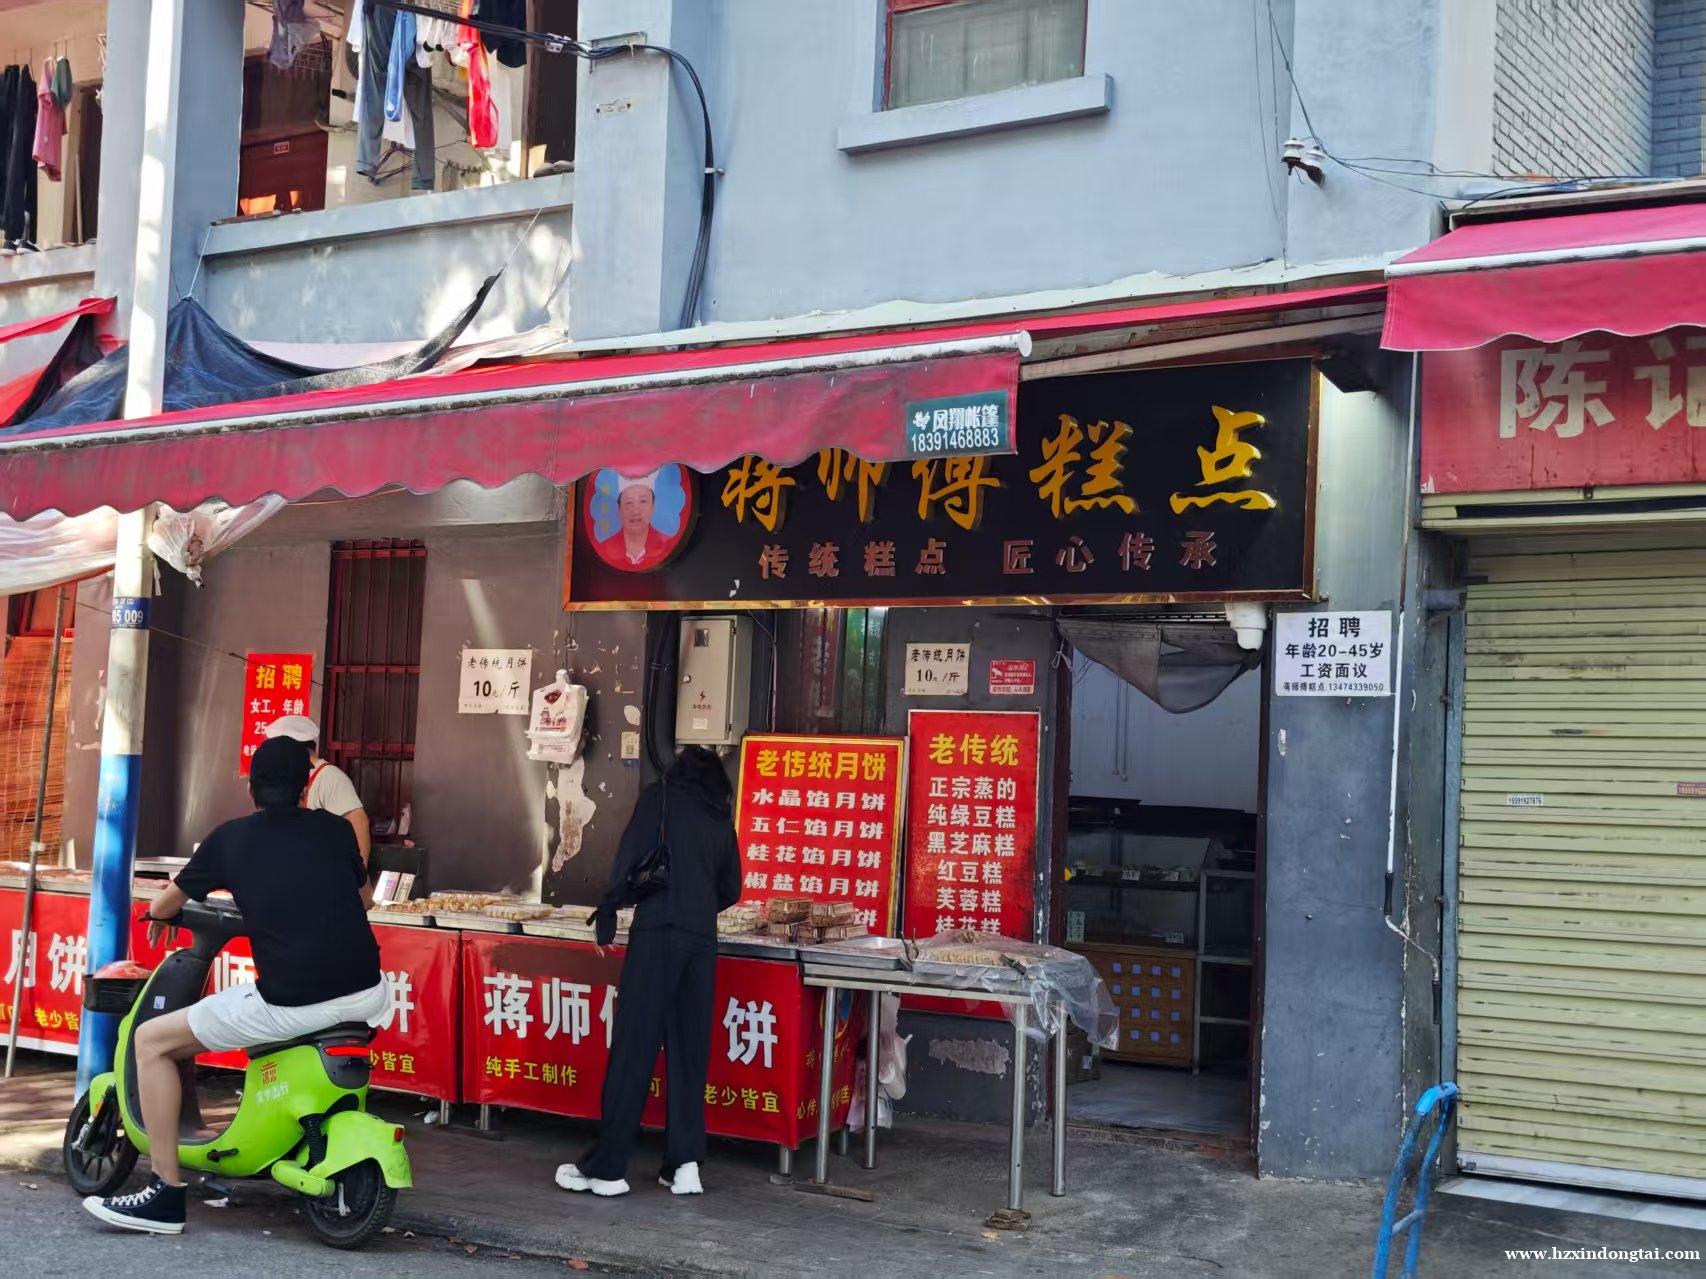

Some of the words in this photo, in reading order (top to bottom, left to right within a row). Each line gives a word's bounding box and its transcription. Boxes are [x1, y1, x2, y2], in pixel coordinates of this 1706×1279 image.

[1500, 337, 1706, 438] 陈记
[912, 428, 999, 452] 18391468883
[758, 538, 947, 579] 传统糕点
[1003, 531, 1217, 575] 匠心传承
[124, 610, 144, 623] 009
[1308, 617, 1361, 638] 招聘
[468, 656, 527, 670] 老传统月饼
[911, 648, 965, 662] 老传统月饼
[1285, 642, 1384, 659] 年龄20-45岁
[256, 664, 303, 689] 招聘
[1300, 662, 1368, 679] 工资面议
[1329, 682, 1384, 692] 13474339050
[928, 733, 1019, 766] 老传统
[756, 749, 887, 781] 老传统月饼
[752, 788, 886, 811] 水晶馅月饼
[928, 777, 1016, 801] 正宗蒸的
[750, 816, 884, 840] 五仁馅月饼
[927, 804, 1016, 828] 纯绿豆糕
[746, 843, 882, 869] 桂花馅月饼
[927, 831, 1016, 856] 黑芝麻糕
[744, 871, 880, 898] 椒盐馅月饼
[937, 860, 1003, 885] 红豆糕
[936, 887, 1002, 913] 芙蓉糕
[4, 929, 88, 995] 月饼
[34, 1008, 81, 1031] 老少皆
[369, 1049, 416, 1074] 少皆宜
[485, 1055, 578, 1088] 纯手工制作
[703, 1083, 780, 1114] 老少皆宜
